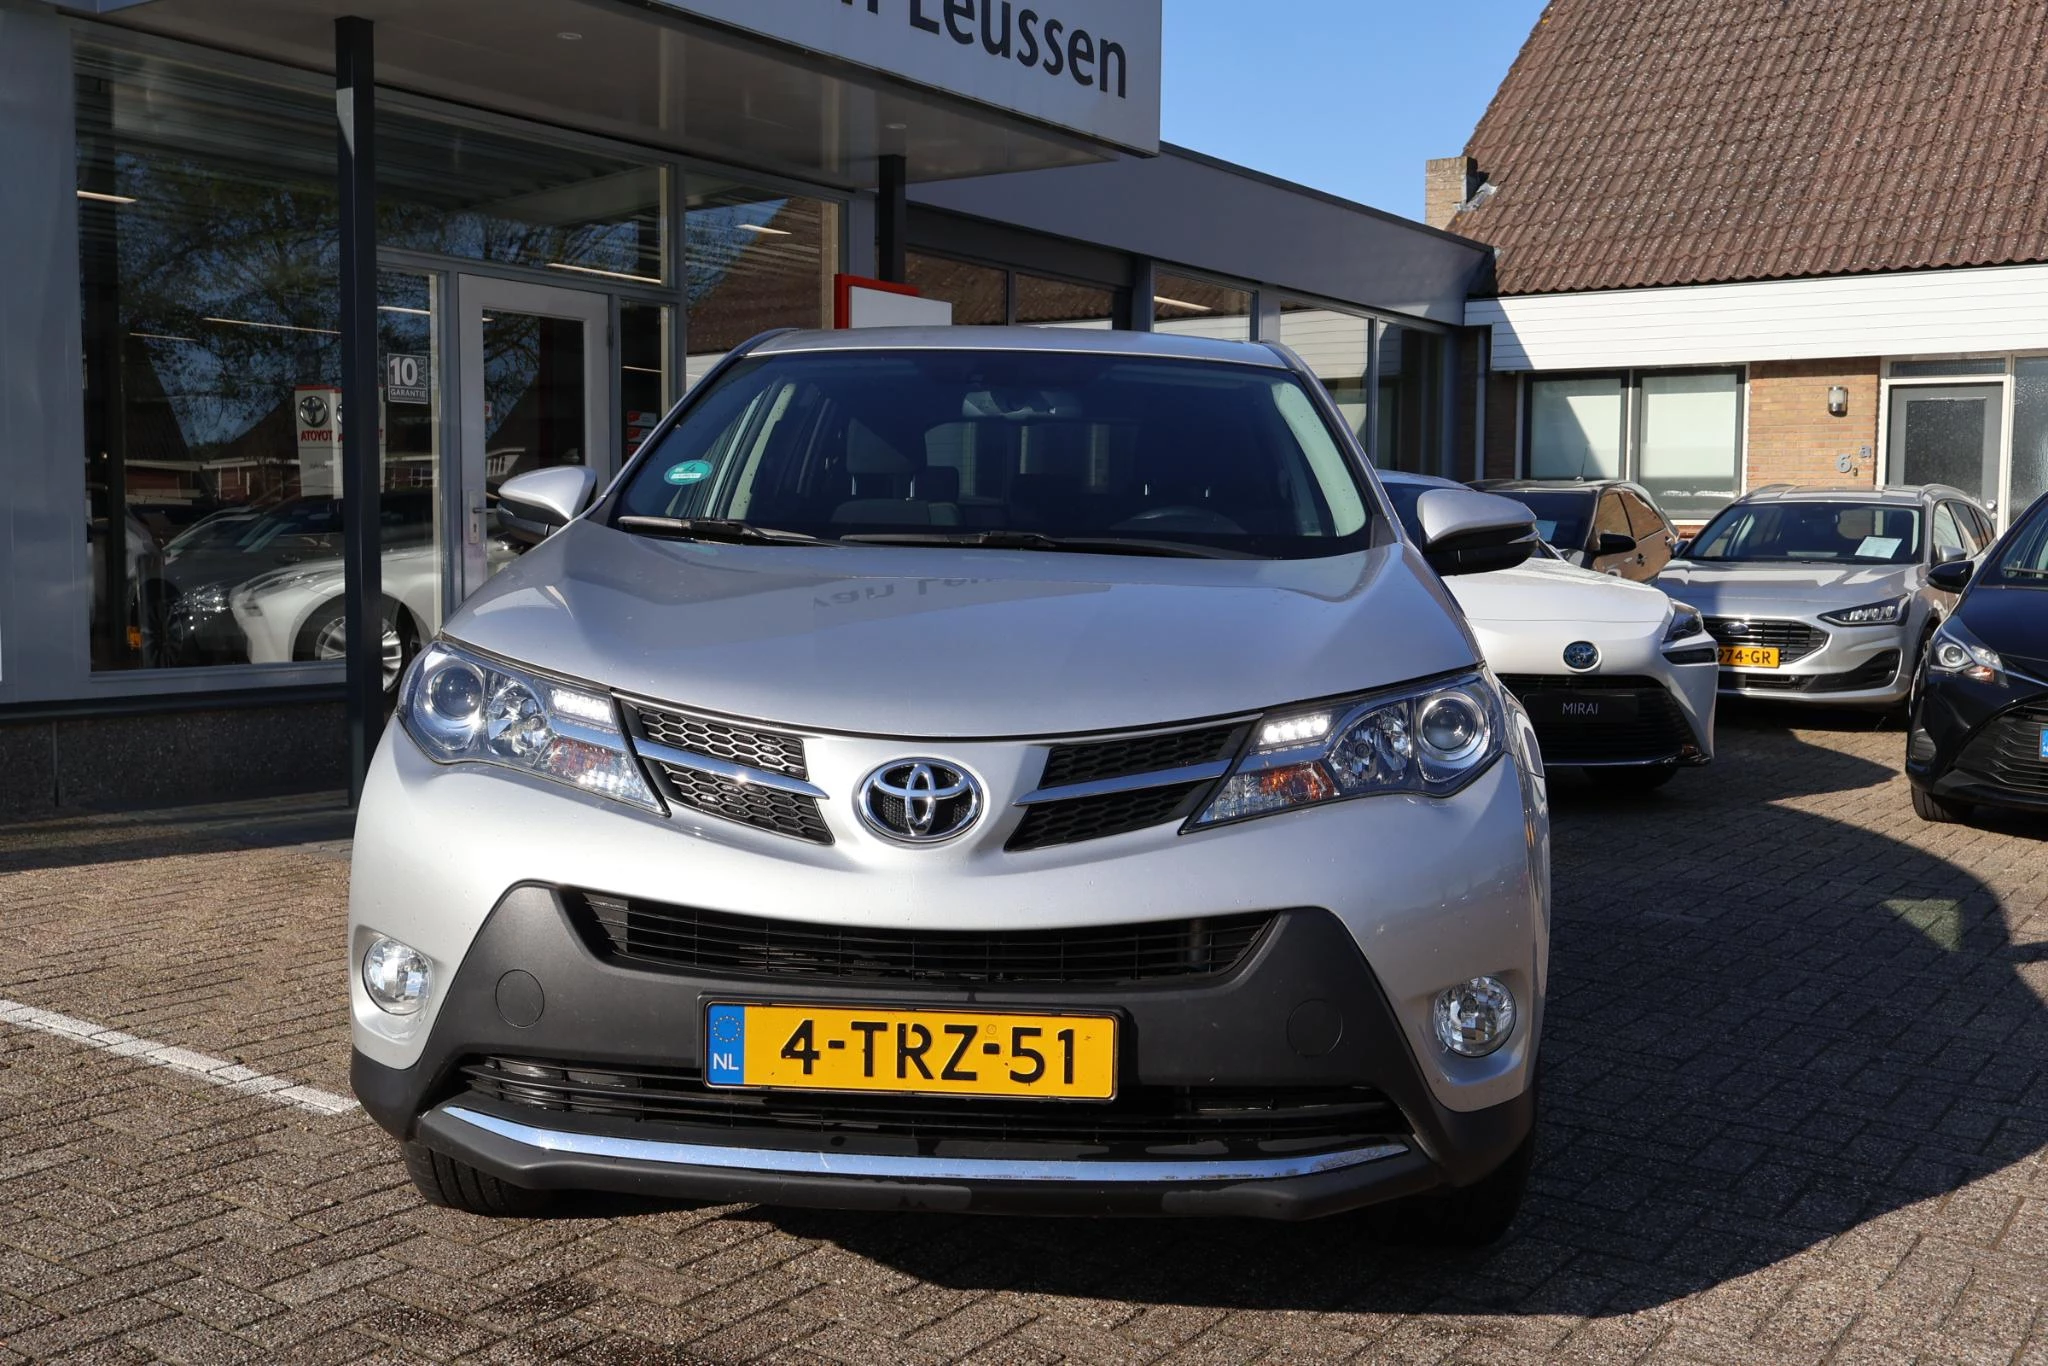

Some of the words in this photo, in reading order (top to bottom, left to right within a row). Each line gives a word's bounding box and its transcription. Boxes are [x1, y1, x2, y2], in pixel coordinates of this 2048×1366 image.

[390, 357, 417, 386] 10
[391, 389, 426, 397] GARANTIE
[1562, 702, 1598, 715] MIRAI
[781, 1019, 1075, 1084] 4-TRZ-51
[713, 1053, 739, 1071] NL
